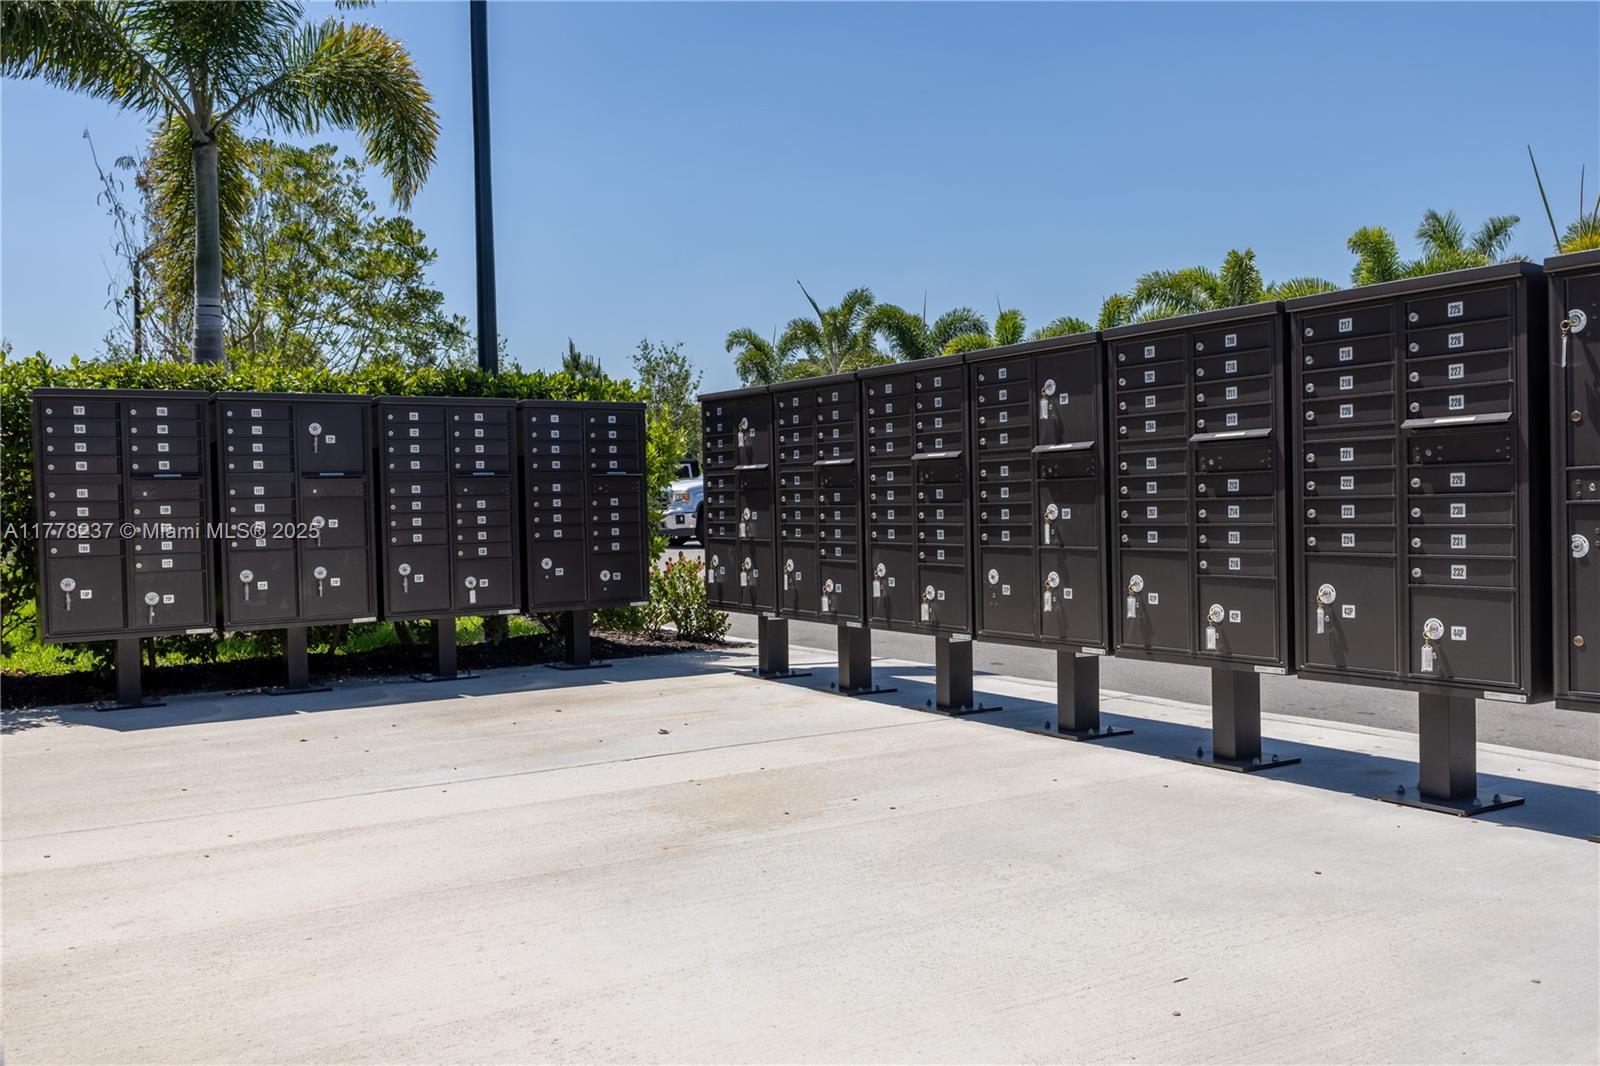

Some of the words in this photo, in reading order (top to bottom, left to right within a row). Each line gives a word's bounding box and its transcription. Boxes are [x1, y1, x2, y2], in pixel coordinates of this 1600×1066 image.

[1449, 304, 1462, 315] 225
[1340, 320, 1351, 330] 217
[1450, 335, 1462, 346] 226
[1450, 366, 1463, 377] 227
[1450, 397, 1463, 408] 228
[1341, 406, 1352, 416] 220
[1341, 450, 1352, 459] 221
[1342, 478, 1353, 487] 222
[1451, 475, 1464, 484] 229
[1343, 507, 1353, 516] 223
[1452, 506, 1464, 515] 230
[1343, 536, 1354, 545] 224
[1452, 536, 1465, 547] 231
[1452, 567, 1465, 577] 232
[1452, 628, 1465, 639] 44P
